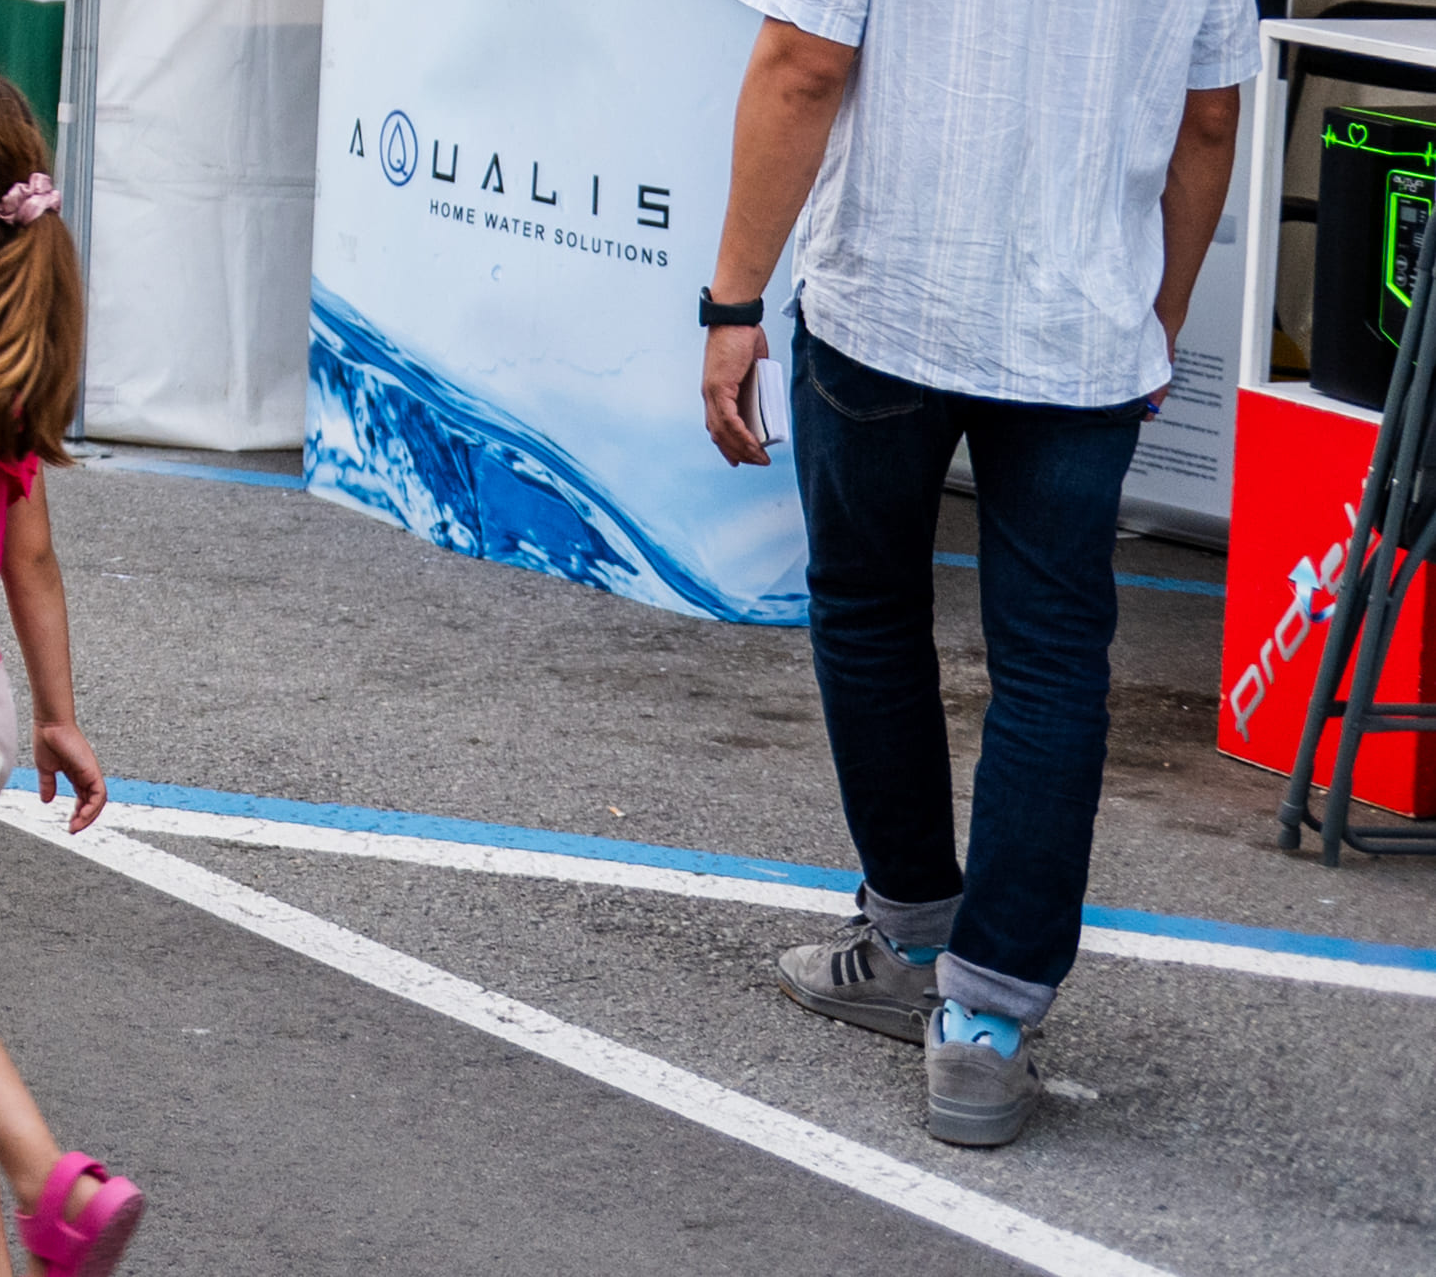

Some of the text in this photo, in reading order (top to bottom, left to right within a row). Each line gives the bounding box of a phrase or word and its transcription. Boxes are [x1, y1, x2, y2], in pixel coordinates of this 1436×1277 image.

[349, 109, 671, 230] AQUALIS
[430, 199, 669, 268] HOME WATER SOLUTIONS
